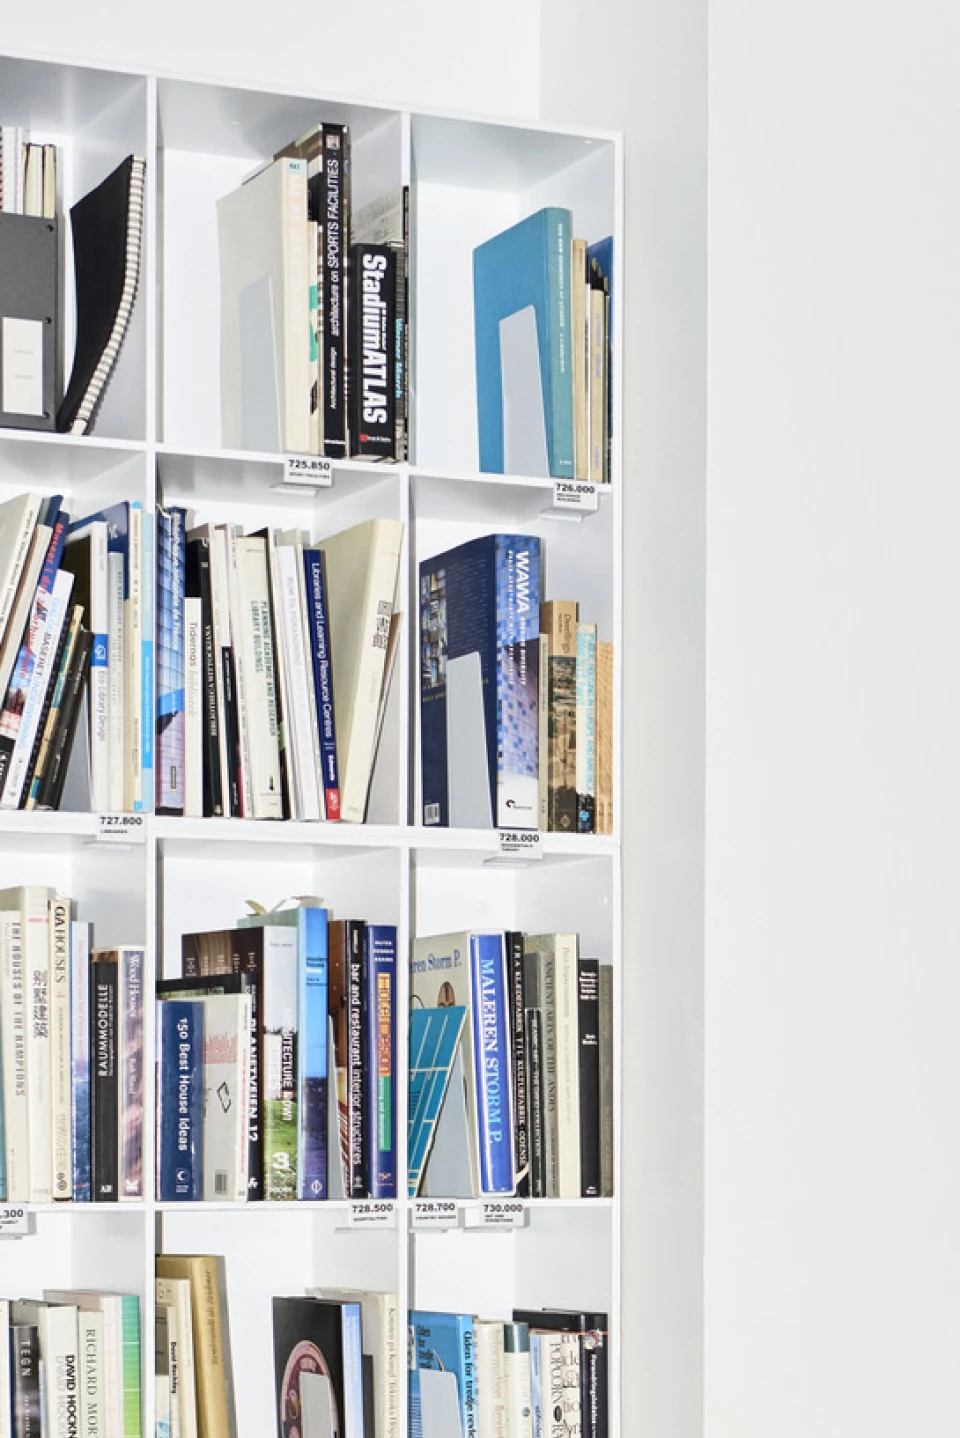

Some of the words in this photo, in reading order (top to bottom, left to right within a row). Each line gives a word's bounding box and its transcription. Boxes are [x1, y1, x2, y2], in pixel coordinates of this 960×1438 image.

[326, 161, 339, 221] FACILITIES
[326, 222, 339, 270] SPORTS
[329, 270, 339, 283] on
[328, 285, 341, 337] architecture
[362, 253, 389, 424] StadiumATLAS
[288, 459, 330, 471] 725.850
[556, 483, 596, 494] 726.000
[310, 562, 322, 600] Libraries
[515, 550, 531, 614] WAWA
[314, 601, 325, 619] and
[316, 620, 328, 659] Learning
[561, 613, 573, 654] Dwellings
[319, 659, 332, 702] Resource
[323, 703, 334, 738] Centres
[100, 816, 143, 826] 727.800
[500, 833, 539, 843] 728.000
[11, 922, 22, 940] THE
[54, 906, 65, 928] GA
[54, 929, 66, 984] HOUSES
[128, 954, 140, 982] Wood
[351, 964, 362, 983] bar
[129, 984, 140, 1019] Houses
[351, 984, 362, 1005] and
[479, 958, 500, 1055] MALEREN
[98, 984, 109, 1077] RAUMMODELLE
[176, 1017, 190, 1040] 150
[352, 1008, 362, 1066] restaurant
[178, 1043, 191, 1071] Best
[178, 1075, 191, 1114] House
[352, 1068, 363, 1108] interior
[484, 1057, 502, 1123] STORM
[178, 1118, 191, 1151] Ideas
[352, 1110, 363, 1166] structures
[488, 1129, 503, 1144] P.
[271, 1151, 290, 1170] 3
[352, 1203, 393, 1213] 728.500
[415, 1203, 456, 1212] 728.700
[483, 1204, 524, 1213] 730.000
[20, 1339, 31, 1377] TEGN
[64, 1354, 77, 1391] DAVID
[84, 1328, 99, 1396] RICHARD
[549, 1342, 564, 1405] POPCORN
